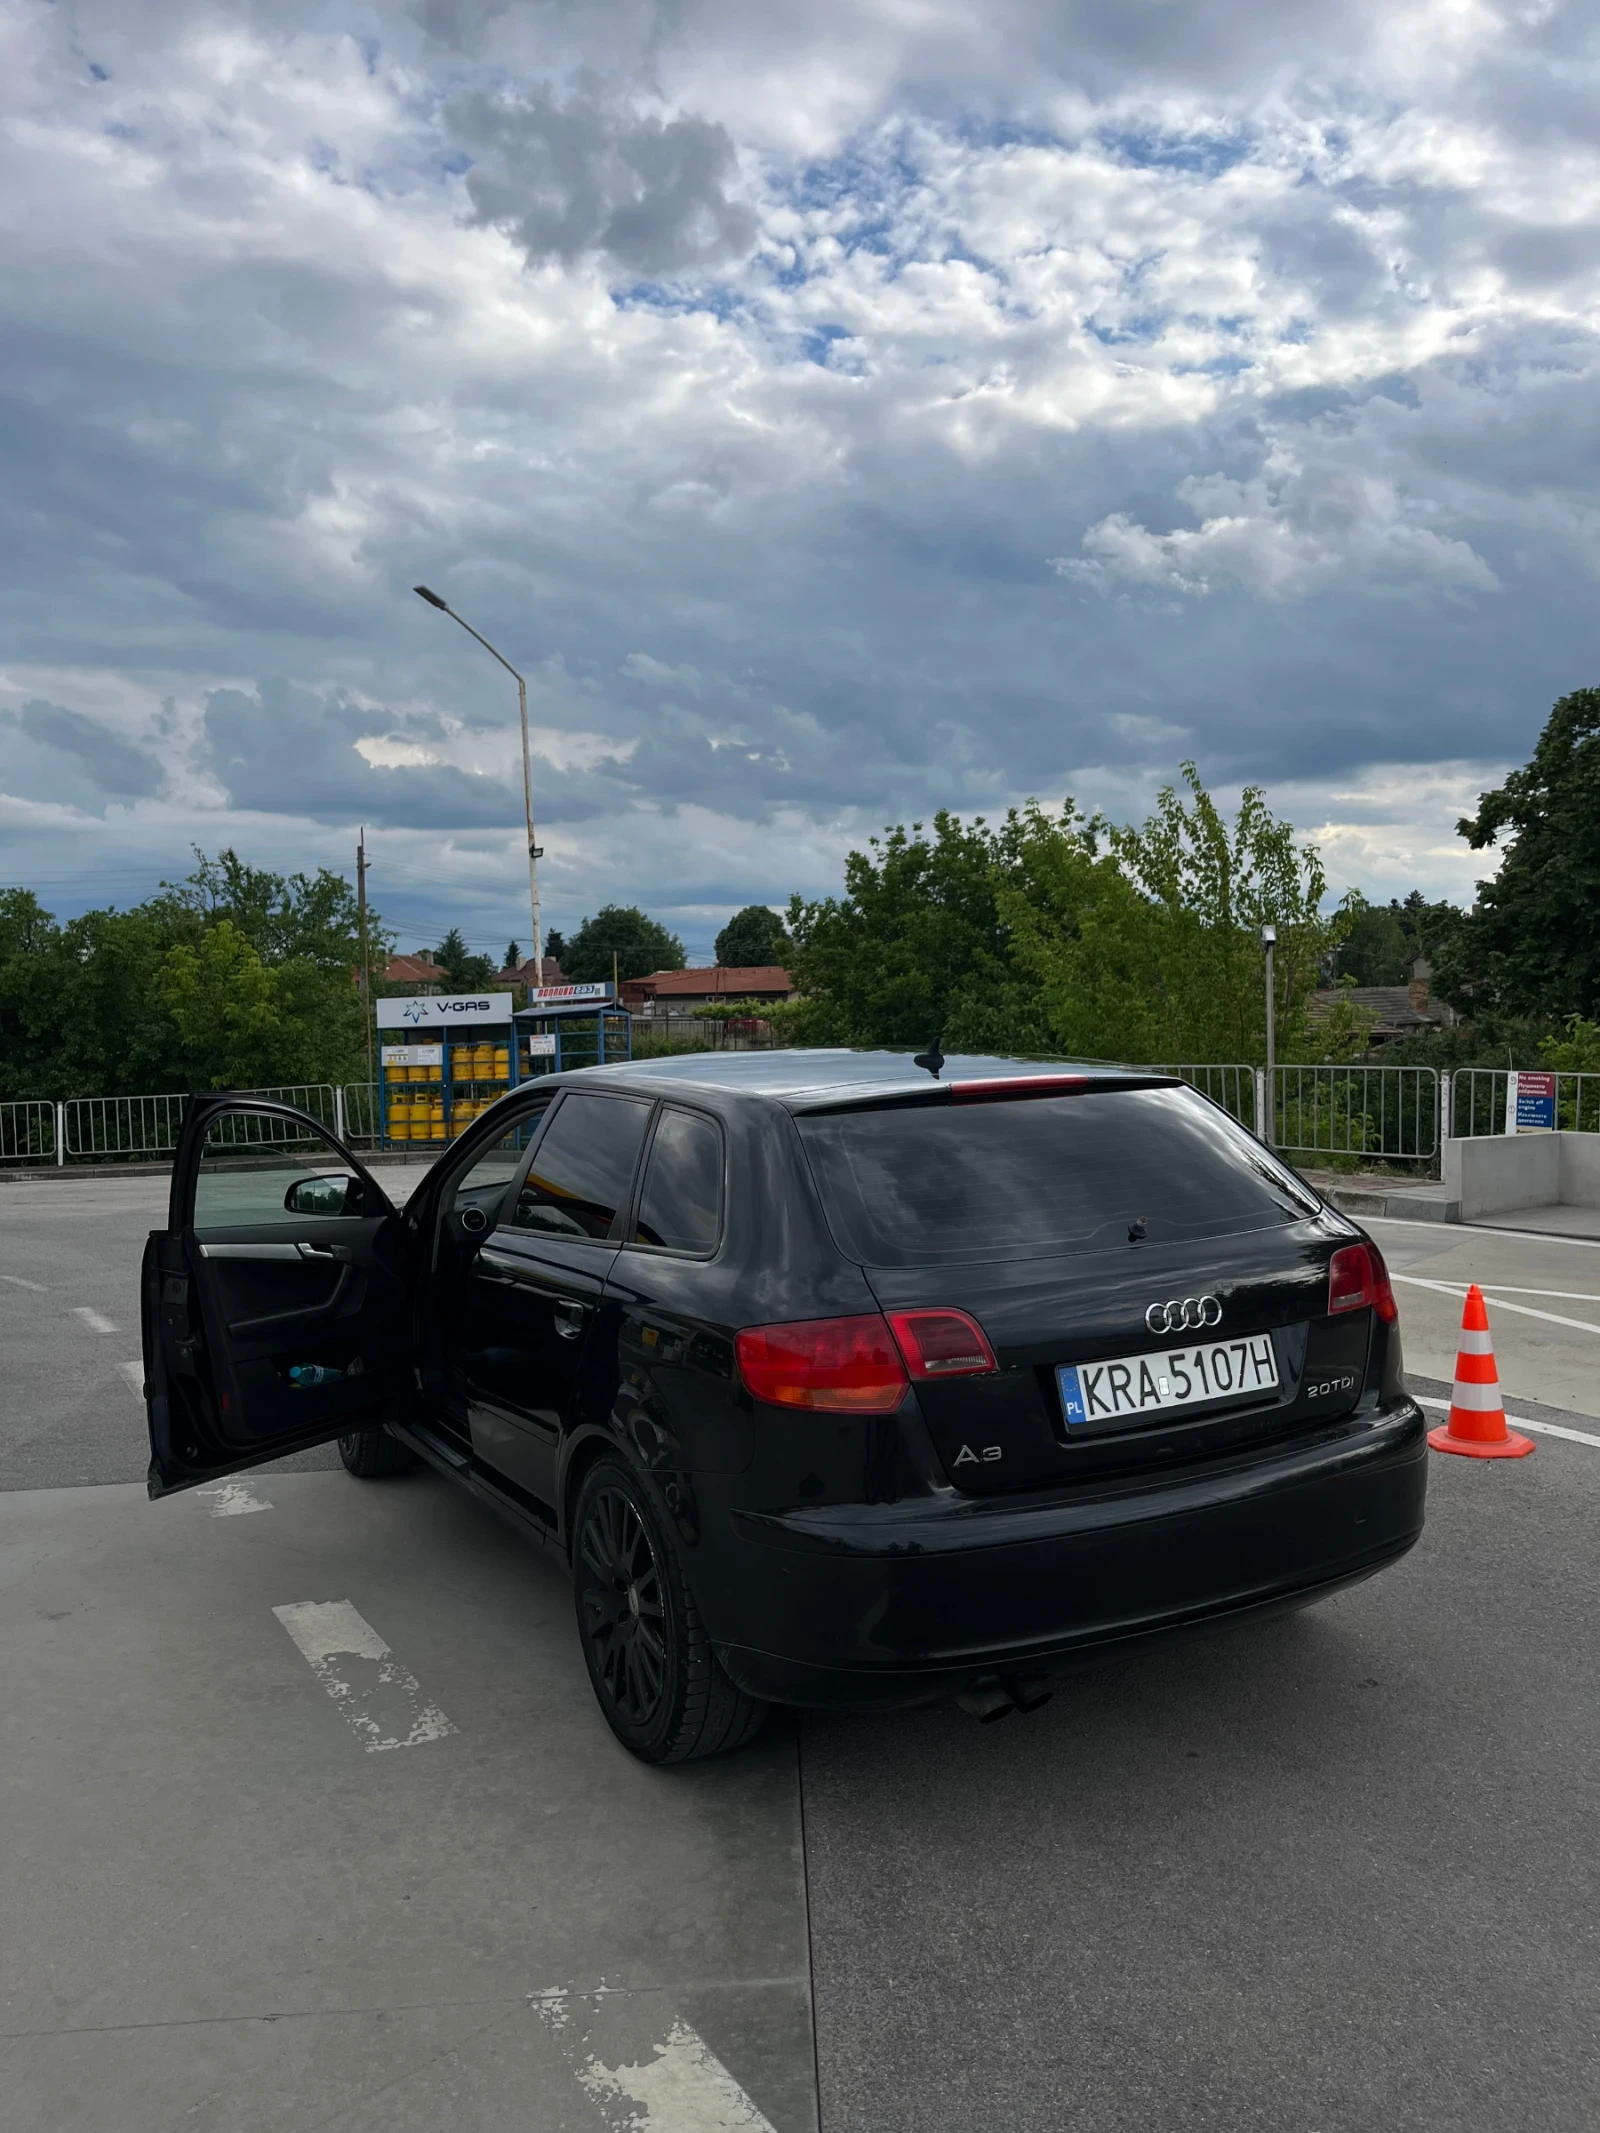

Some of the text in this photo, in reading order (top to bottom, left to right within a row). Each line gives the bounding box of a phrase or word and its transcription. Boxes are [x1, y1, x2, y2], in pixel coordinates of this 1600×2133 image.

[437, 1001, 490, 1013] V-GAS
[1082, 1339, 1275, 1416] KRA 5107H
[1067, 1402, 1082, 1415] PL
[953, 1444, 1002, 1467] A3
